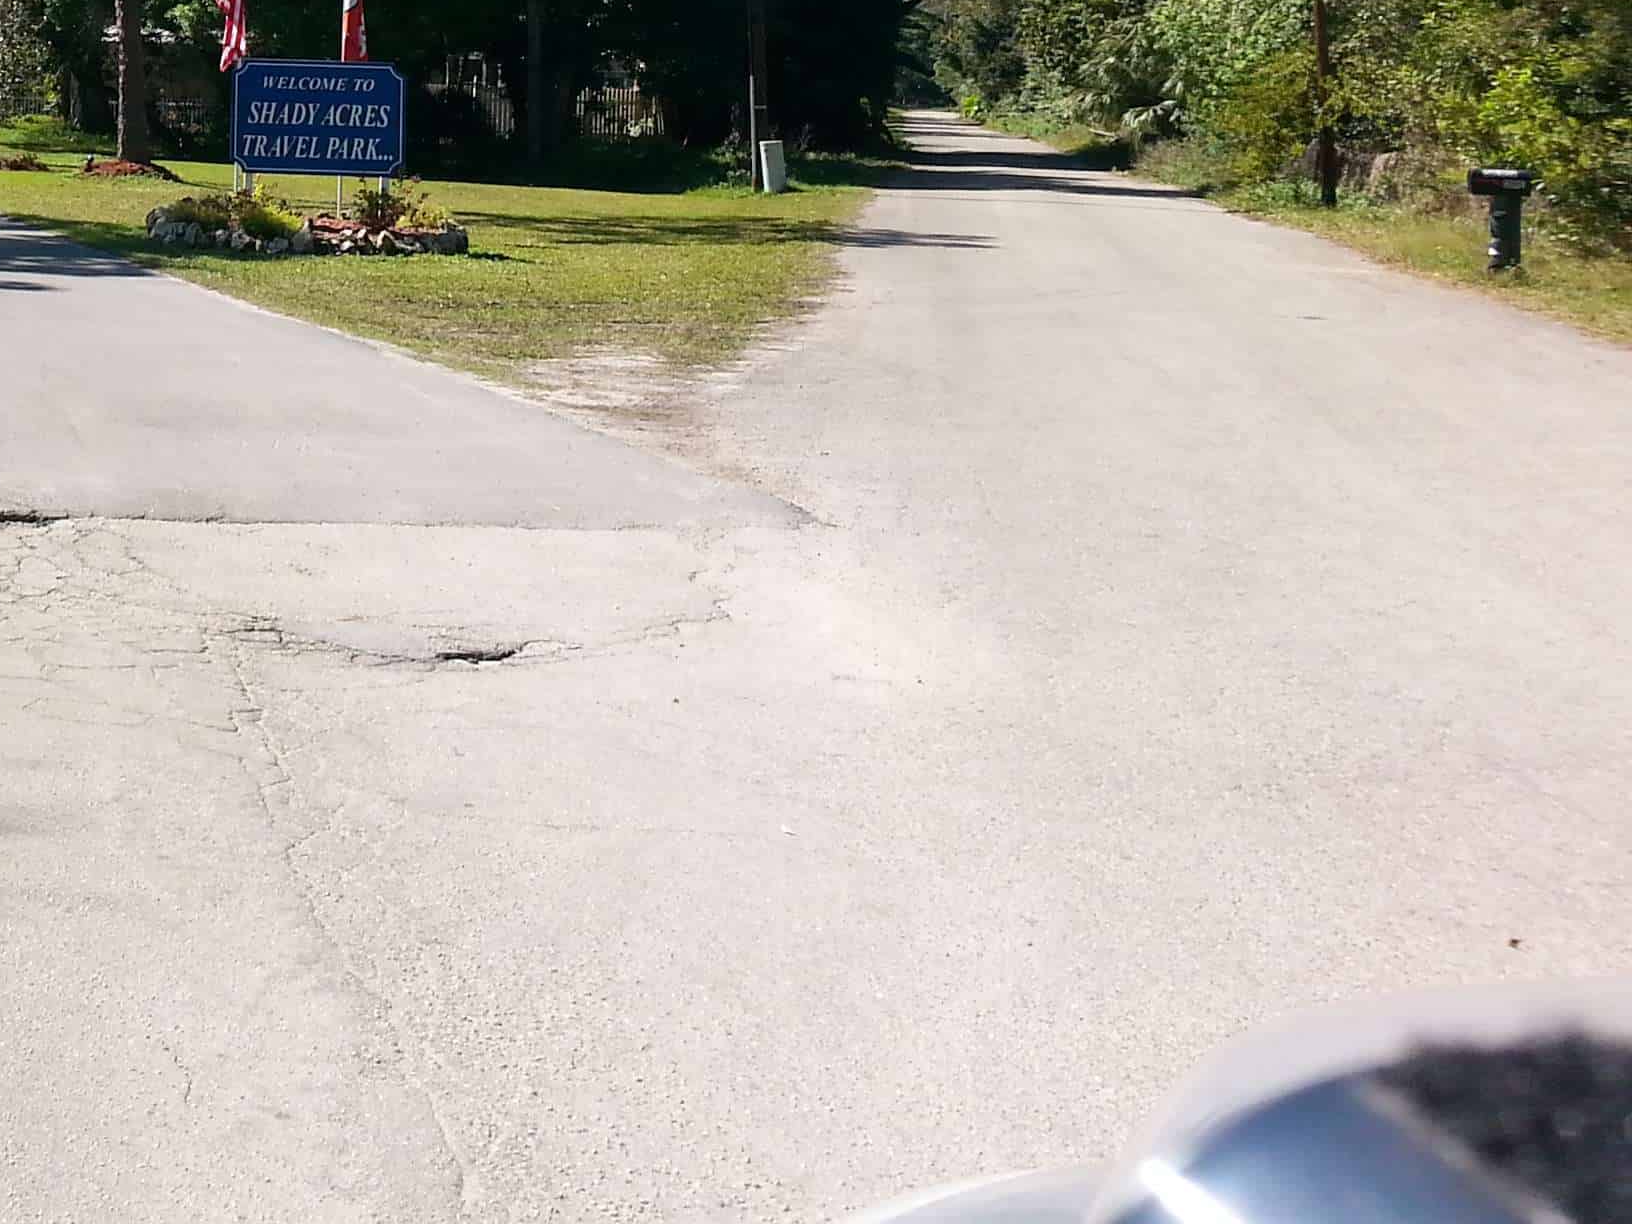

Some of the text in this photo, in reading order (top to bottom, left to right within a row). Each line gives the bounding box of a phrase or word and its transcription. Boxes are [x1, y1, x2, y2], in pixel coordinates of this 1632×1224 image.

[263, 76, 375, 92] WELCOME TO
[247, 101, 391, 127] SHADY ACRES
[242, 134, 321, 159] TRAVEL
